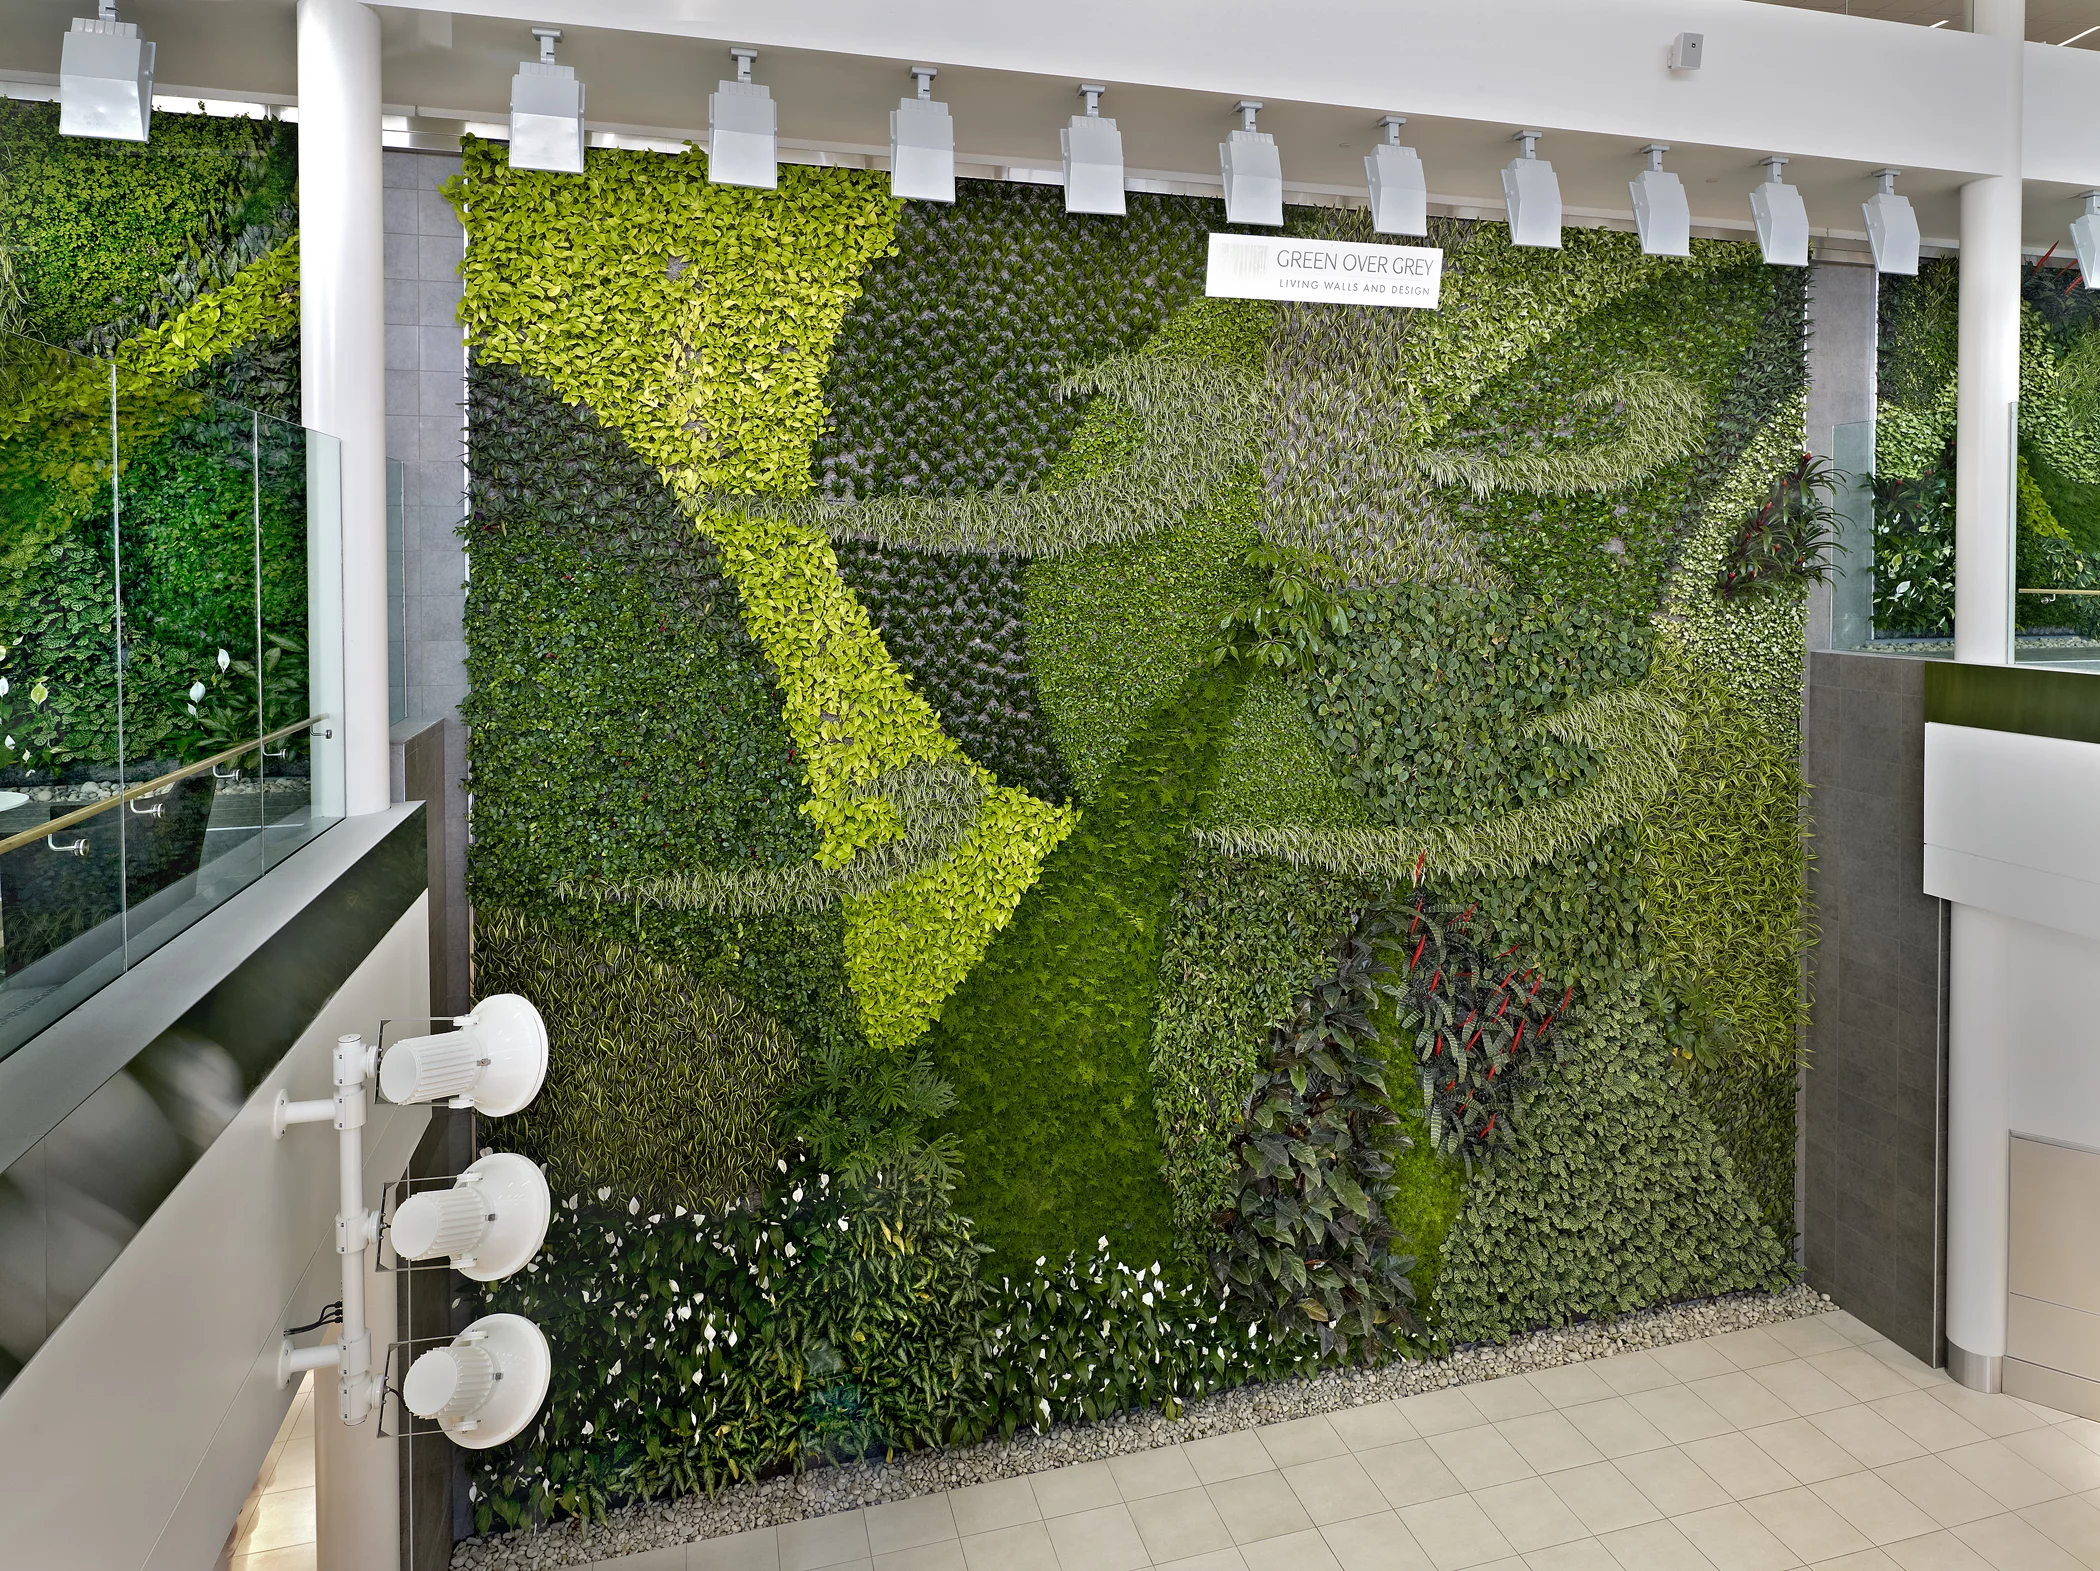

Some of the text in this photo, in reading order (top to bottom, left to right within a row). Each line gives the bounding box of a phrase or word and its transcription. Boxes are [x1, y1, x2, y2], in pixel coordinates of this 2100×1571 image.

[1277, 249, 1434, 276] GREEN OVER GREY
[1279, 279, 1430, 296] LIVING WALLS AND DESIGN
